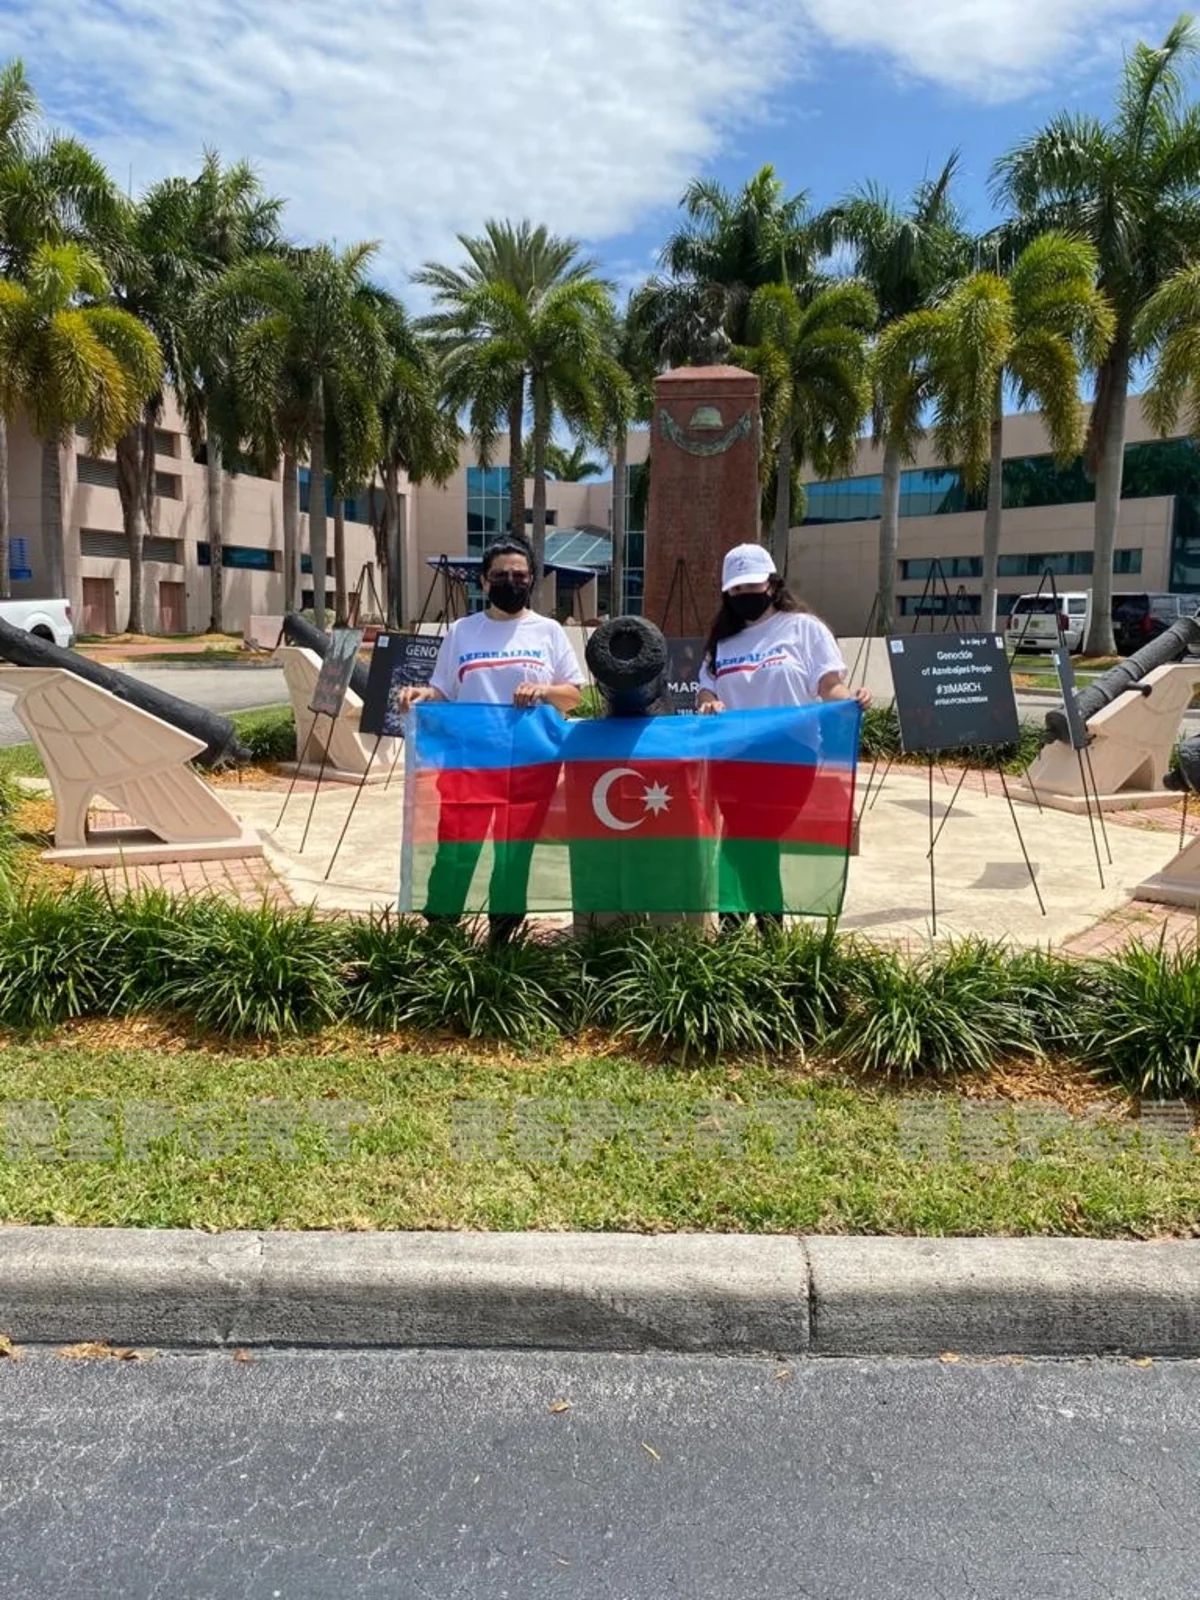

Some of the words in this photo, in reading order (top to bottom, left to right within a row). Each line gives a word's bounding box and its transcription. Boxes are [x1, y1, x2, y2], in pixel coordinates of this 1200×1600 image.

[405, 643, 438, 658] GENO
[937, 650, 973, 660] Genocide
[921, 667, 930, 675] of
[971, 664, 992, 674] People
